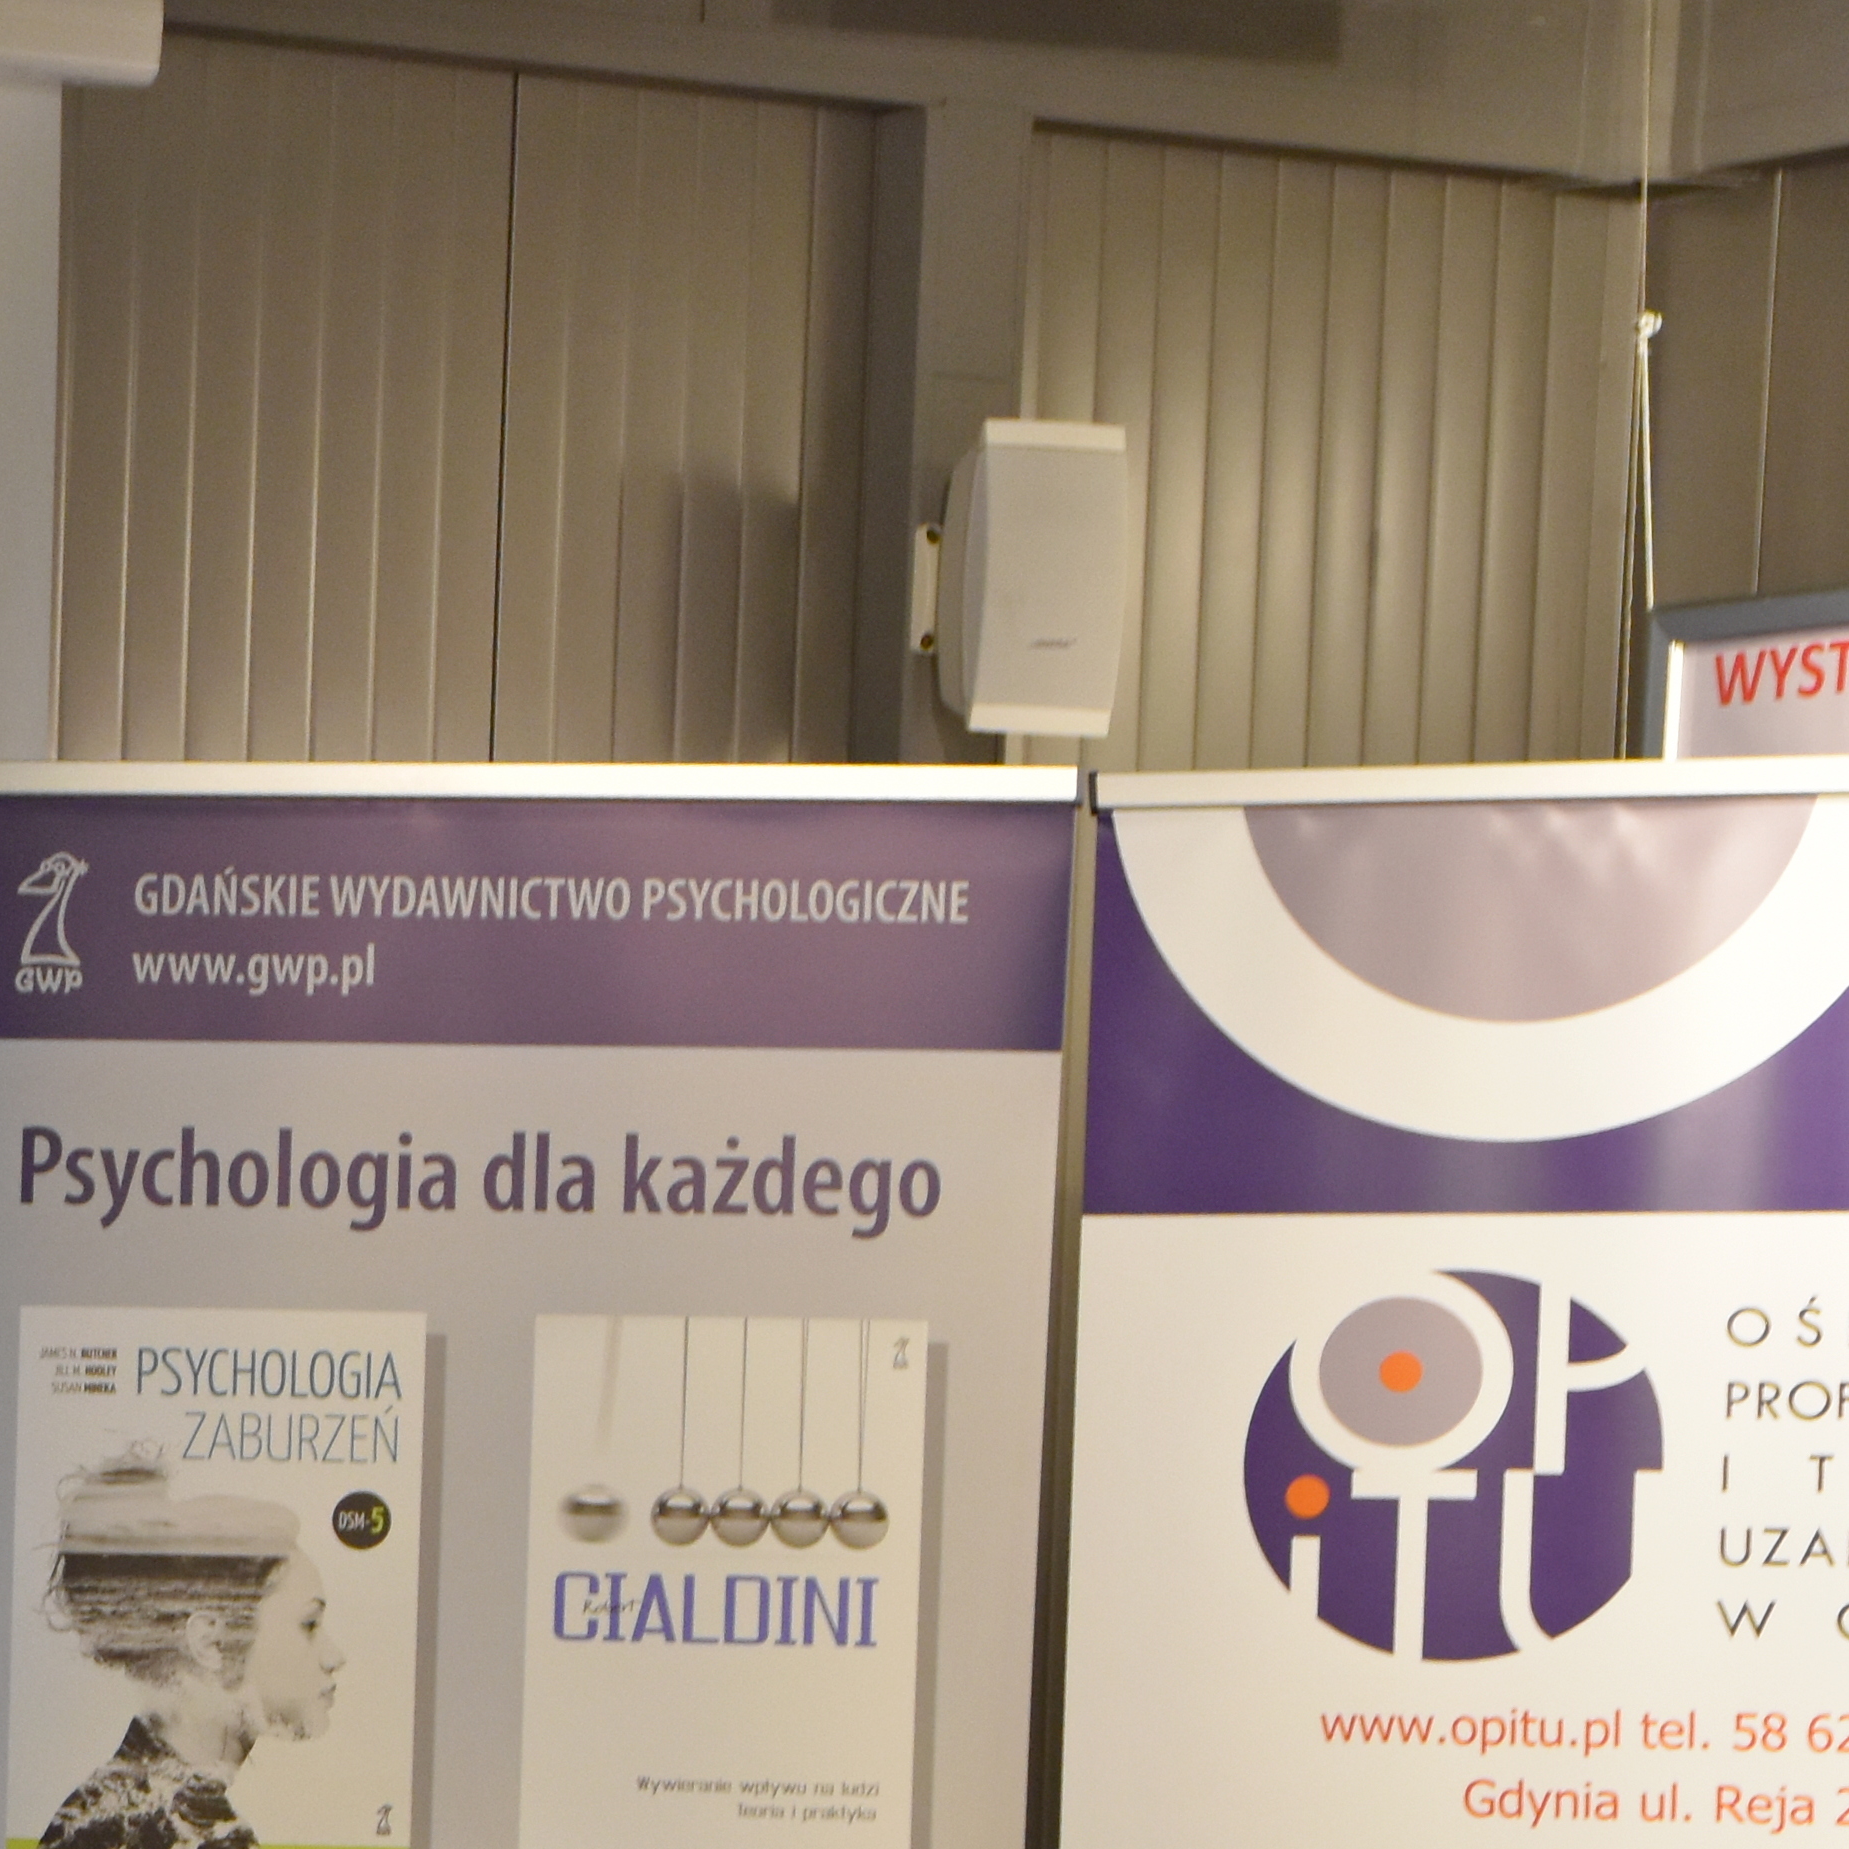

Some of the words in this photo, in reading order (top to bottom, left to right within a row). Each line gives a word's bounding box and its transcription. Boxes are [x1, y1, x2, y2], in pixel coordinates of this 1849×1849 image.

[133, 865, 321, 918] GDAŃSKIE
[329, 875, 631, 923] WYDAWNICTWO
[640, 877, 970, 926] PSYCHOLOGICZNE
[131, 942, 377, 997] www.gwp.pl
[19, 1123, 458, 1233] Psychologia
[481, 1130, 596, 1214] dla
[621, 1132, 943, 1240] każdego
[1725, 1296, 1849, 1349] OŚ
[136, 1347, 403, 1400] PSYCHOLOGIA
[182, 1405, 400, 1464] ZABURZEŃ
[338, 1505, 386, 1536] DSM-5
[1718, 1526, 1849, 1568] UZA
[552, 1569, 880, 1648] CIALDINI
[1320, 1708, 1623, 1758] www.opitu.pl
[1640, 1711, 1711, 1751] tel.
[1732, 1711, 1789, 1753] 58
[636, 1774, 733, 1797] Wywieranie
[1461, 1779, 1621, 1829] Gdynia
[1639, 1784, 1693, 1823] ul.
[1714, 1784, 1815, 1836] Reja
[801, 1805, 878, 1826] praktyka
